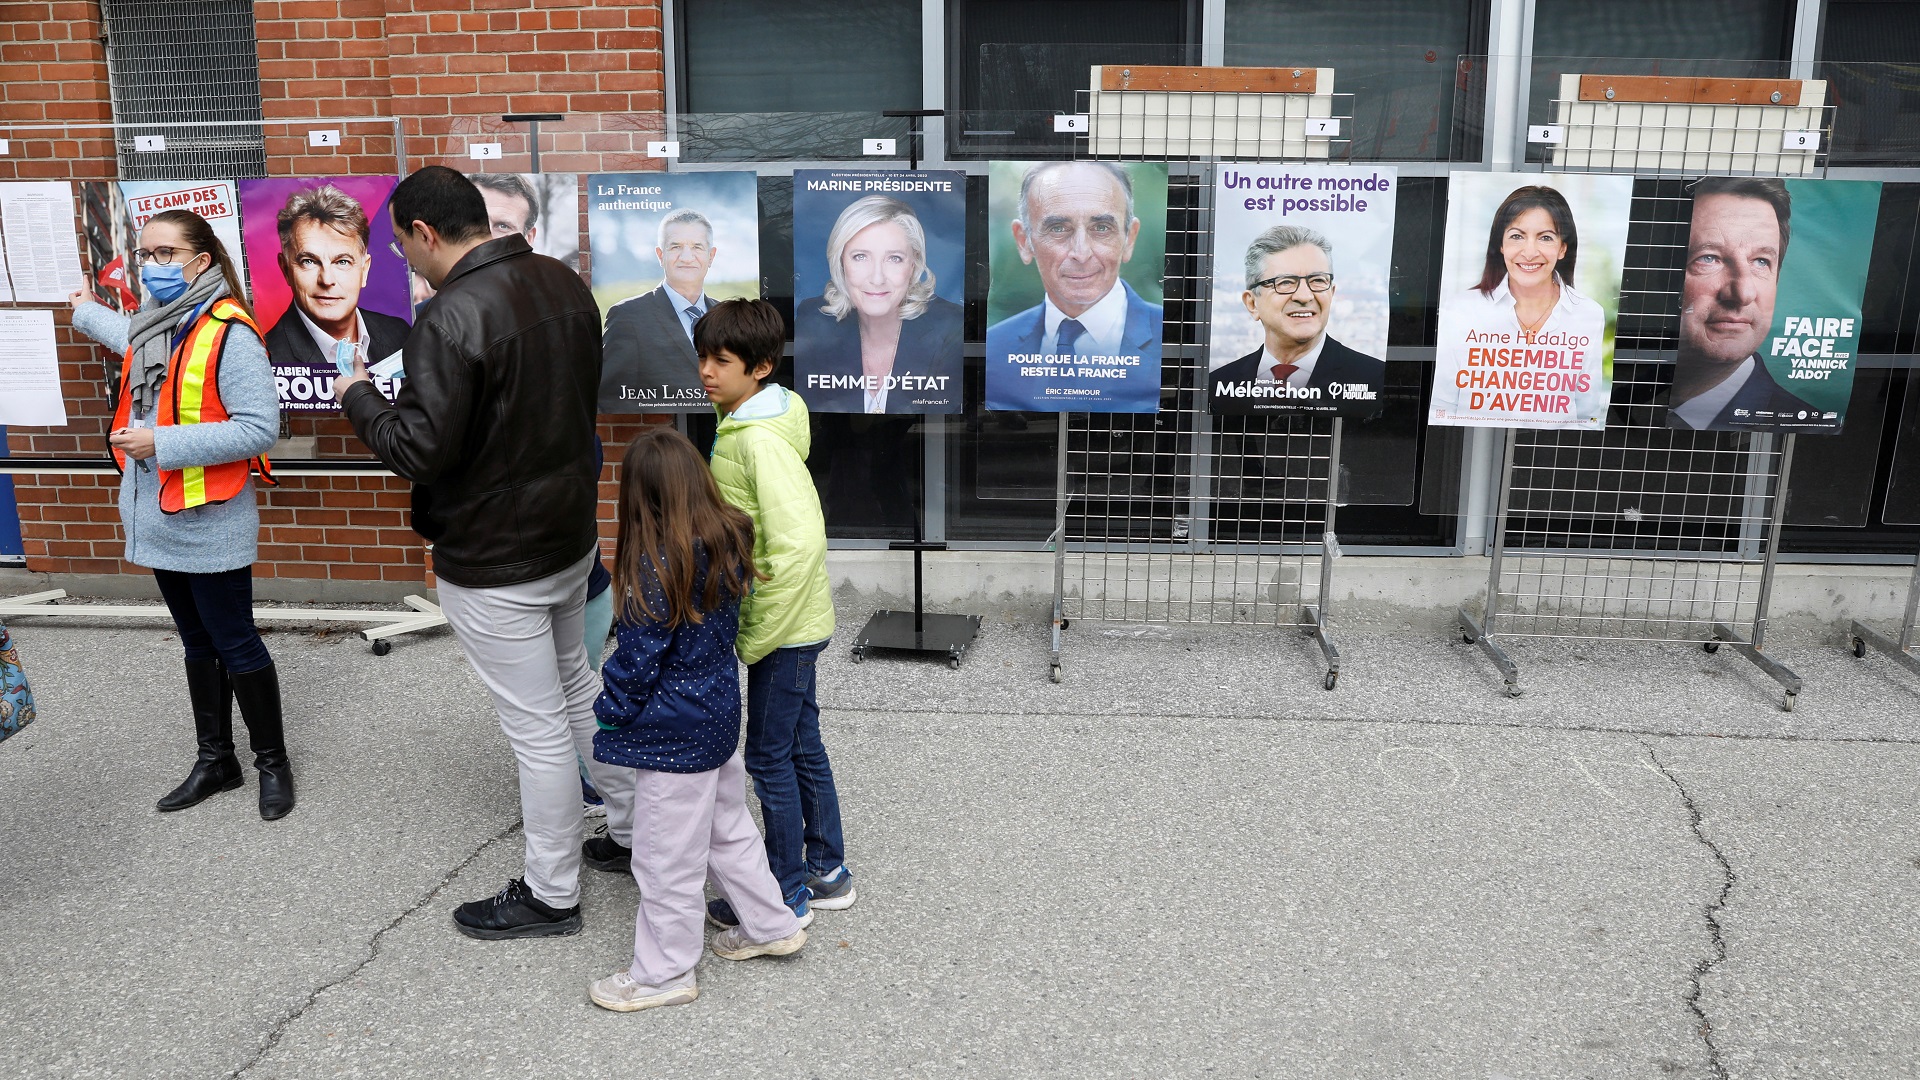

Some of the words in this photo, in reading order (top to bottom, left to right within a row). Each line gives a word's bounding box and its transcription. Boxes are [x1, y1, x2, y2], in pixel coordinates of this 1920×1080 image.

[1069, 120, 1075, 128] 6
[1320, 124, 1326, 132] 7
[321, 134, 328, 142] 2
[1543, 130, 1550, 139] 8
[147, 139, 153, 147] 1
[877, 143, 883, 151] 5
[1799, 137, 1806, 145] 9
[483, 147, 489, 155] 3
[807, 180, 862, 191] MARINE
[865, 178, 952, 192] PRÉSIDENTE
[1224, 171, 1251, 190] Un
[1256, 173, 1313, 190] autre
[1317, 173, 1390, 192] monde
[598, 185, 614, 196] La
[618, 184, 661, 196] France
[138, 200, 152, 212] LE
[154, 194, 190, 209] CAMP
[193, 189, 217, 203] DES
[598, 199, 672, 212] authentique
[1244, 194, 1276, 211] est
[1282, 193, 1368, 217] possible
[1784, 317, 1854, 338] FAIRE
[1465, 328, 1511, 344] Anne
[1516, 330, 1590, 350] Hidalgo
[1770, 337, 1835, 358] FACE
[1008, 353, 1043, 364] POUR
[1044, 354, 1071, 365] QUE
[1073, 355, 1089, 365] LA
[1091, 355, 1140, 366] FRANCE
[1467, 347, 1585, 370] ENSEMBLE
[1790, 358, 1848, 370] YANNICK
[271, 367, 311, 376] FABIEN
[1020, 367, 1058, 377] RESTE
[1060, 367, 1076, 377] LA
[1078, 368, 1127, 379] FRANCE
[1788, 370, 1831, 380] JADOT
[807, 374, 878, 390] FEMME
[883, 371, 950, 391] D'ÉTAT
[1254, 377, 1284, 386] Jean-Luc
[1455, 369, 1592, 393] CHANGEONS
[619, 385, 657, 400] JEAN
[1045, 387, 1062, 395] ÉRIC
[1063, 388, 1101, 396] ZEMMOUR
[1215, 381, 1322, 400] Mélenchon
[1343, 383, 1369, 392] L'UNION
[1342, 391, 1377, 400] POPULAIRE
[1469, 391, 1571, 414] D'AVENIR
